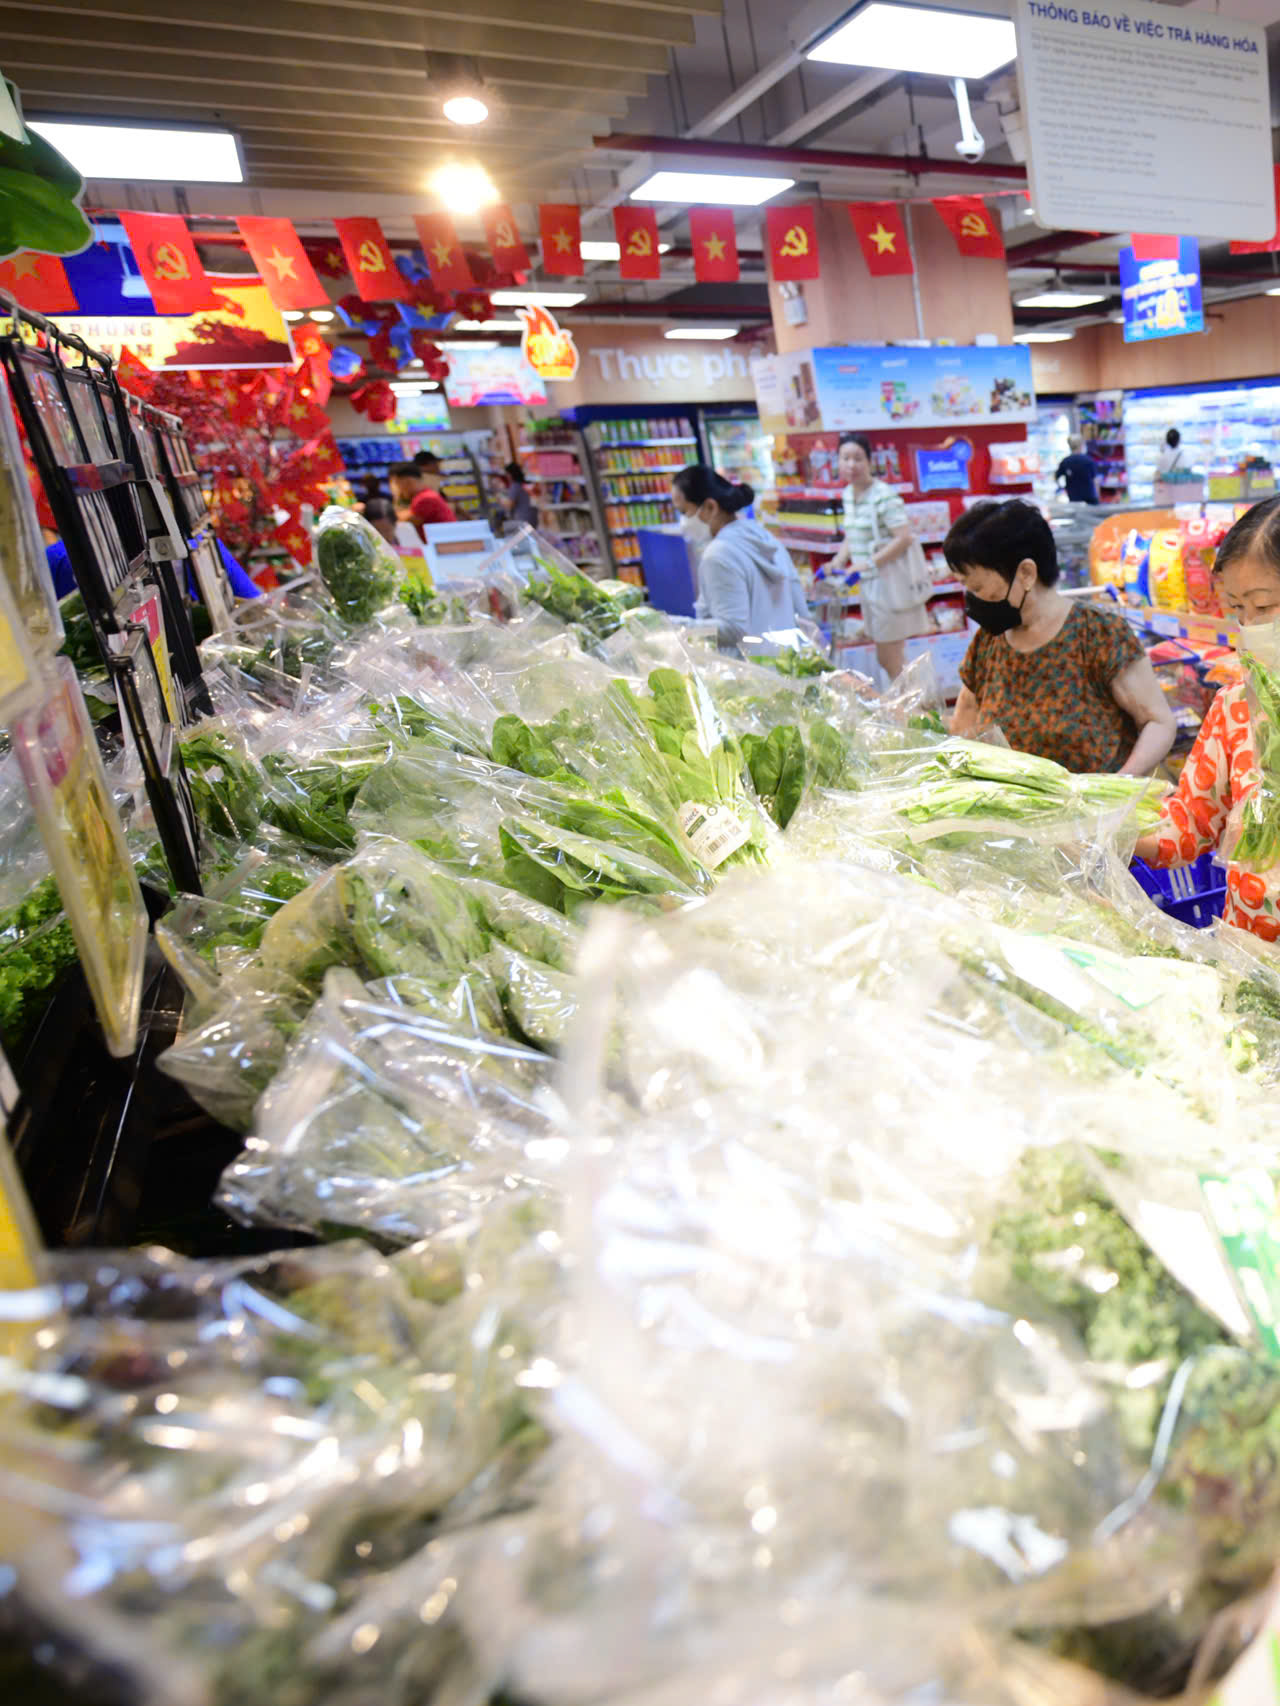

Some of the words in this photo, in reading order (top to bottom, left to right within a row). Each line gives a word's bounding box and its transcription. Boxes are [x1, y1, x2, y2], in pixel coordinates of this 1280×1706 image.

[1028, 2, 1079, 24] THÔNG
[1082, 10, 1111, 30] BÁO
[1113, 13, 1131, 33] VỀ
[1134, 21, 1164, 40] VIỆC
[1195, 31, 1230, 50] HÀNG
[1232, 36, 1259, 54] HÓA
[590, 347, 691, 385] Thực
